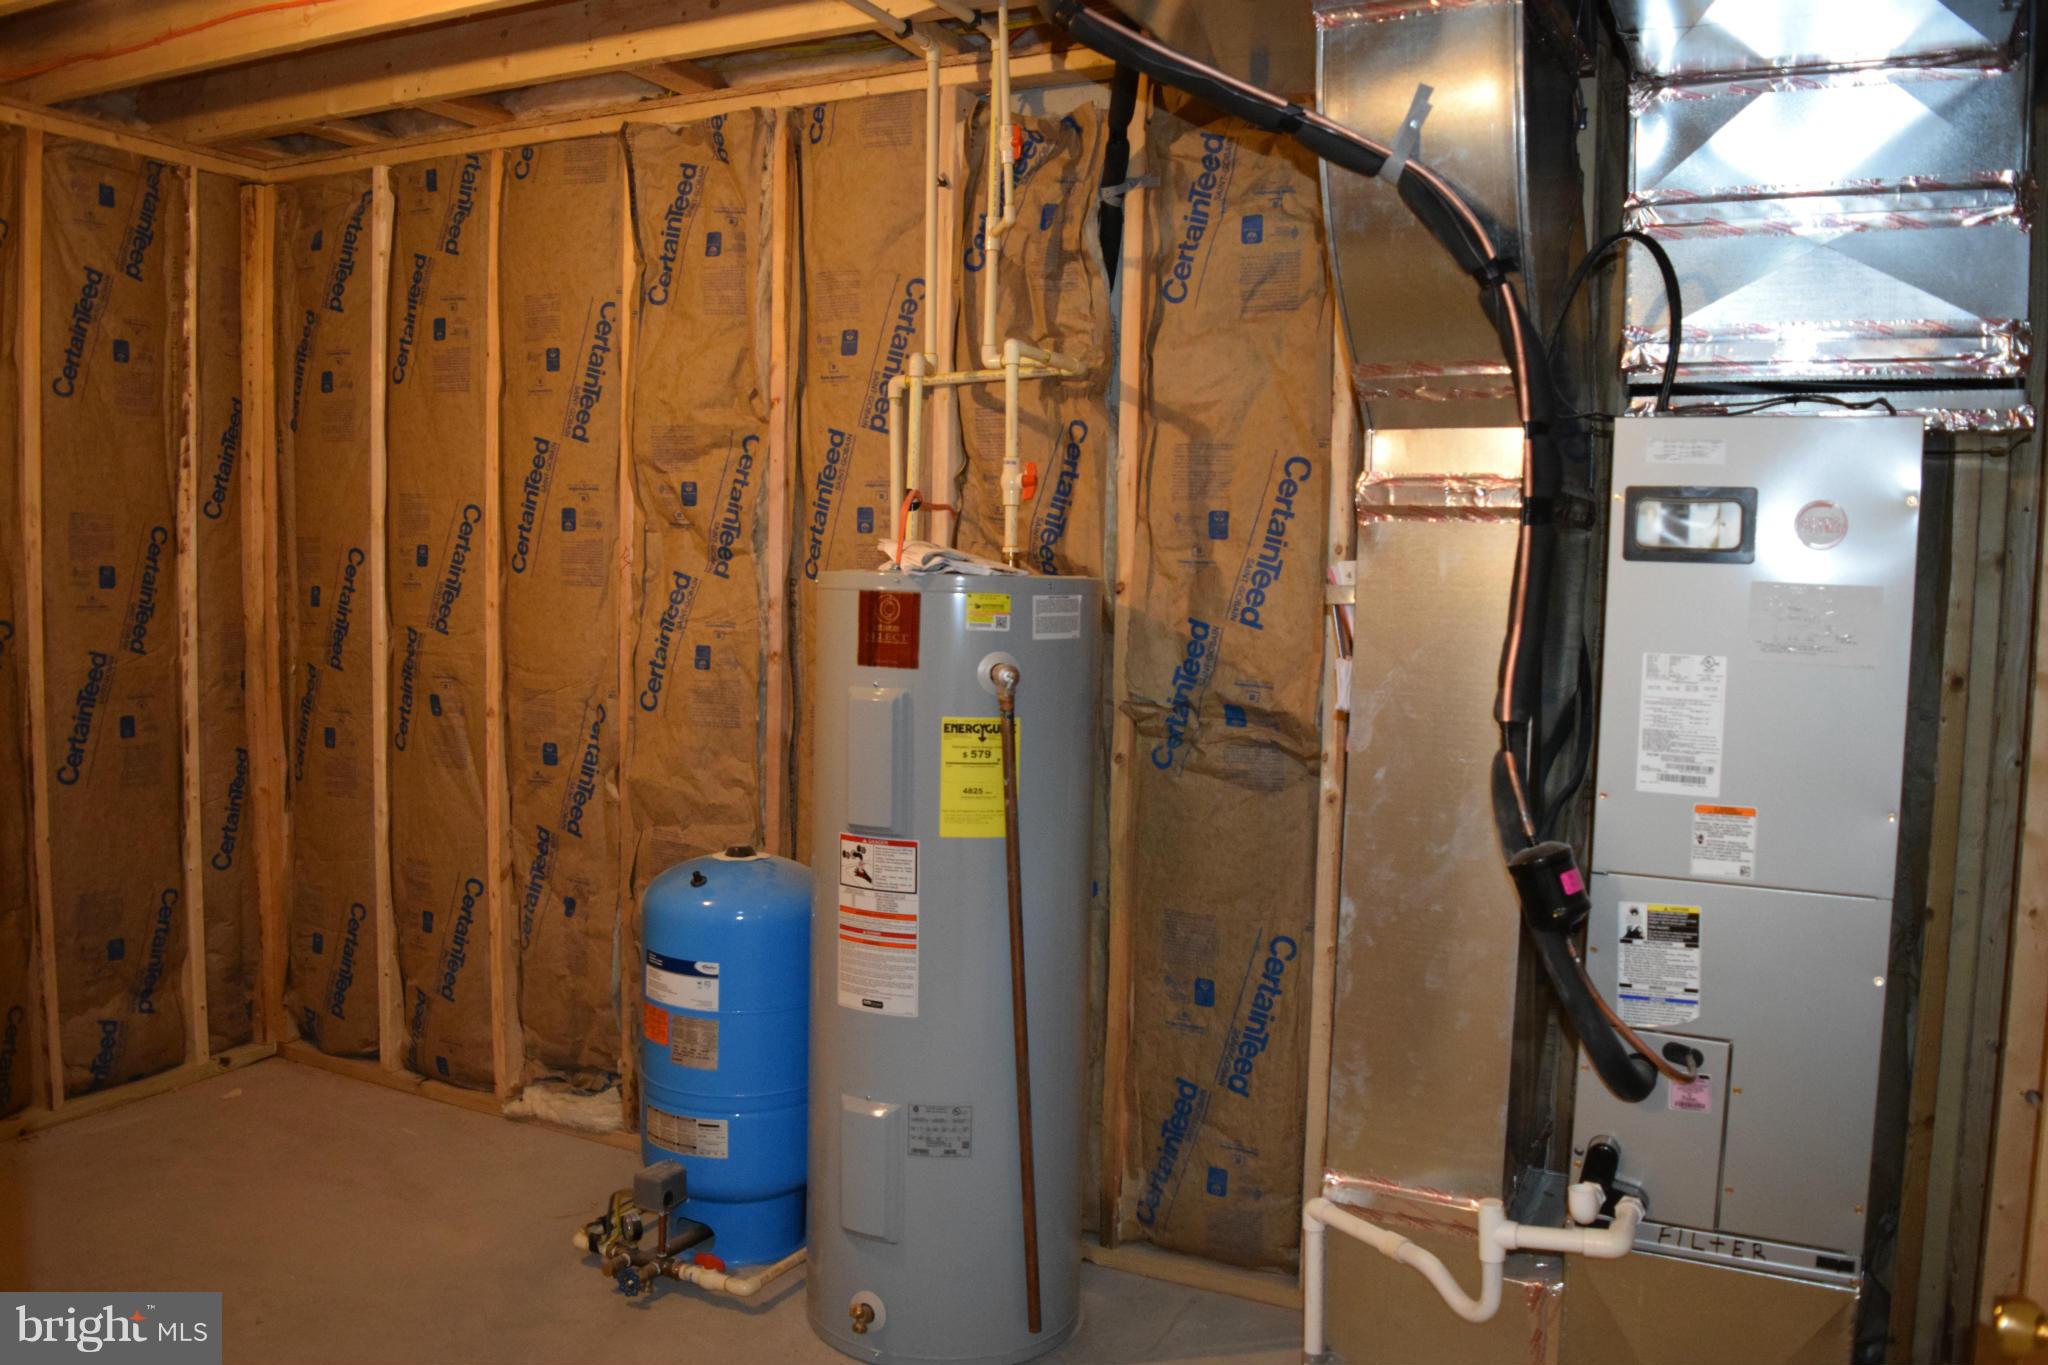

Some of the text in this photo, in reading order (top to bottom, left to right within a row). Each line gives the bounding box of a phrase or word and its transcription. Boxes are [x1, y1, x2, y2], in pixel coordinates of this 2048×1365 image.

[445, 153, 483, 256] rtainTeed
[648, 163, 698, 307] CertainTeed
[1161, 132, 1225, 304] CertainTeed
[52, 266, 103, 398] CertainTeed
[392, 253, 427, 385] CertainTeed
[571, 301, 616, 443] CertainTeed
[204, 397, 242, 519] CertainTeed
[511, 436, 551, 574] CertainTeed
[713, 433, 760, 579] CertainTeed
[805, 428, 846, 581] CertainTeed
[130, 526, 168, 655] CertainTeed
[330, 547, 365, 671] CertainTeed
[431, 503, 482, 636] CertainTeed
[1239, 456, 1312, 630] CertainTeed
[395, 626, 418, 752] CertainTeed
[639, 570, 691, 712] CertainTeed
[1152, 617, 1211, 770] CertainTeed
[56, 651, 108, 786] CertainTeed
[567, 703, 606, 838] CertainTeed
[944, 723, 1017, 735] ENERGYGU
[970, 750, 992, 759] 579
[211, 746, 248, 871] CertainTeed
[436, 878, 484, 1003] CertainTeed
[521, 825, 551, 950] CertainTeed
[331, 902, 367, 1020] CertainTeed
[1227, 935, 1297, 1097] CertainTeed
[1136, 1077, 1199, 1225] CertainTeed
[1656, 1226, 1767, 1261] FILTER
